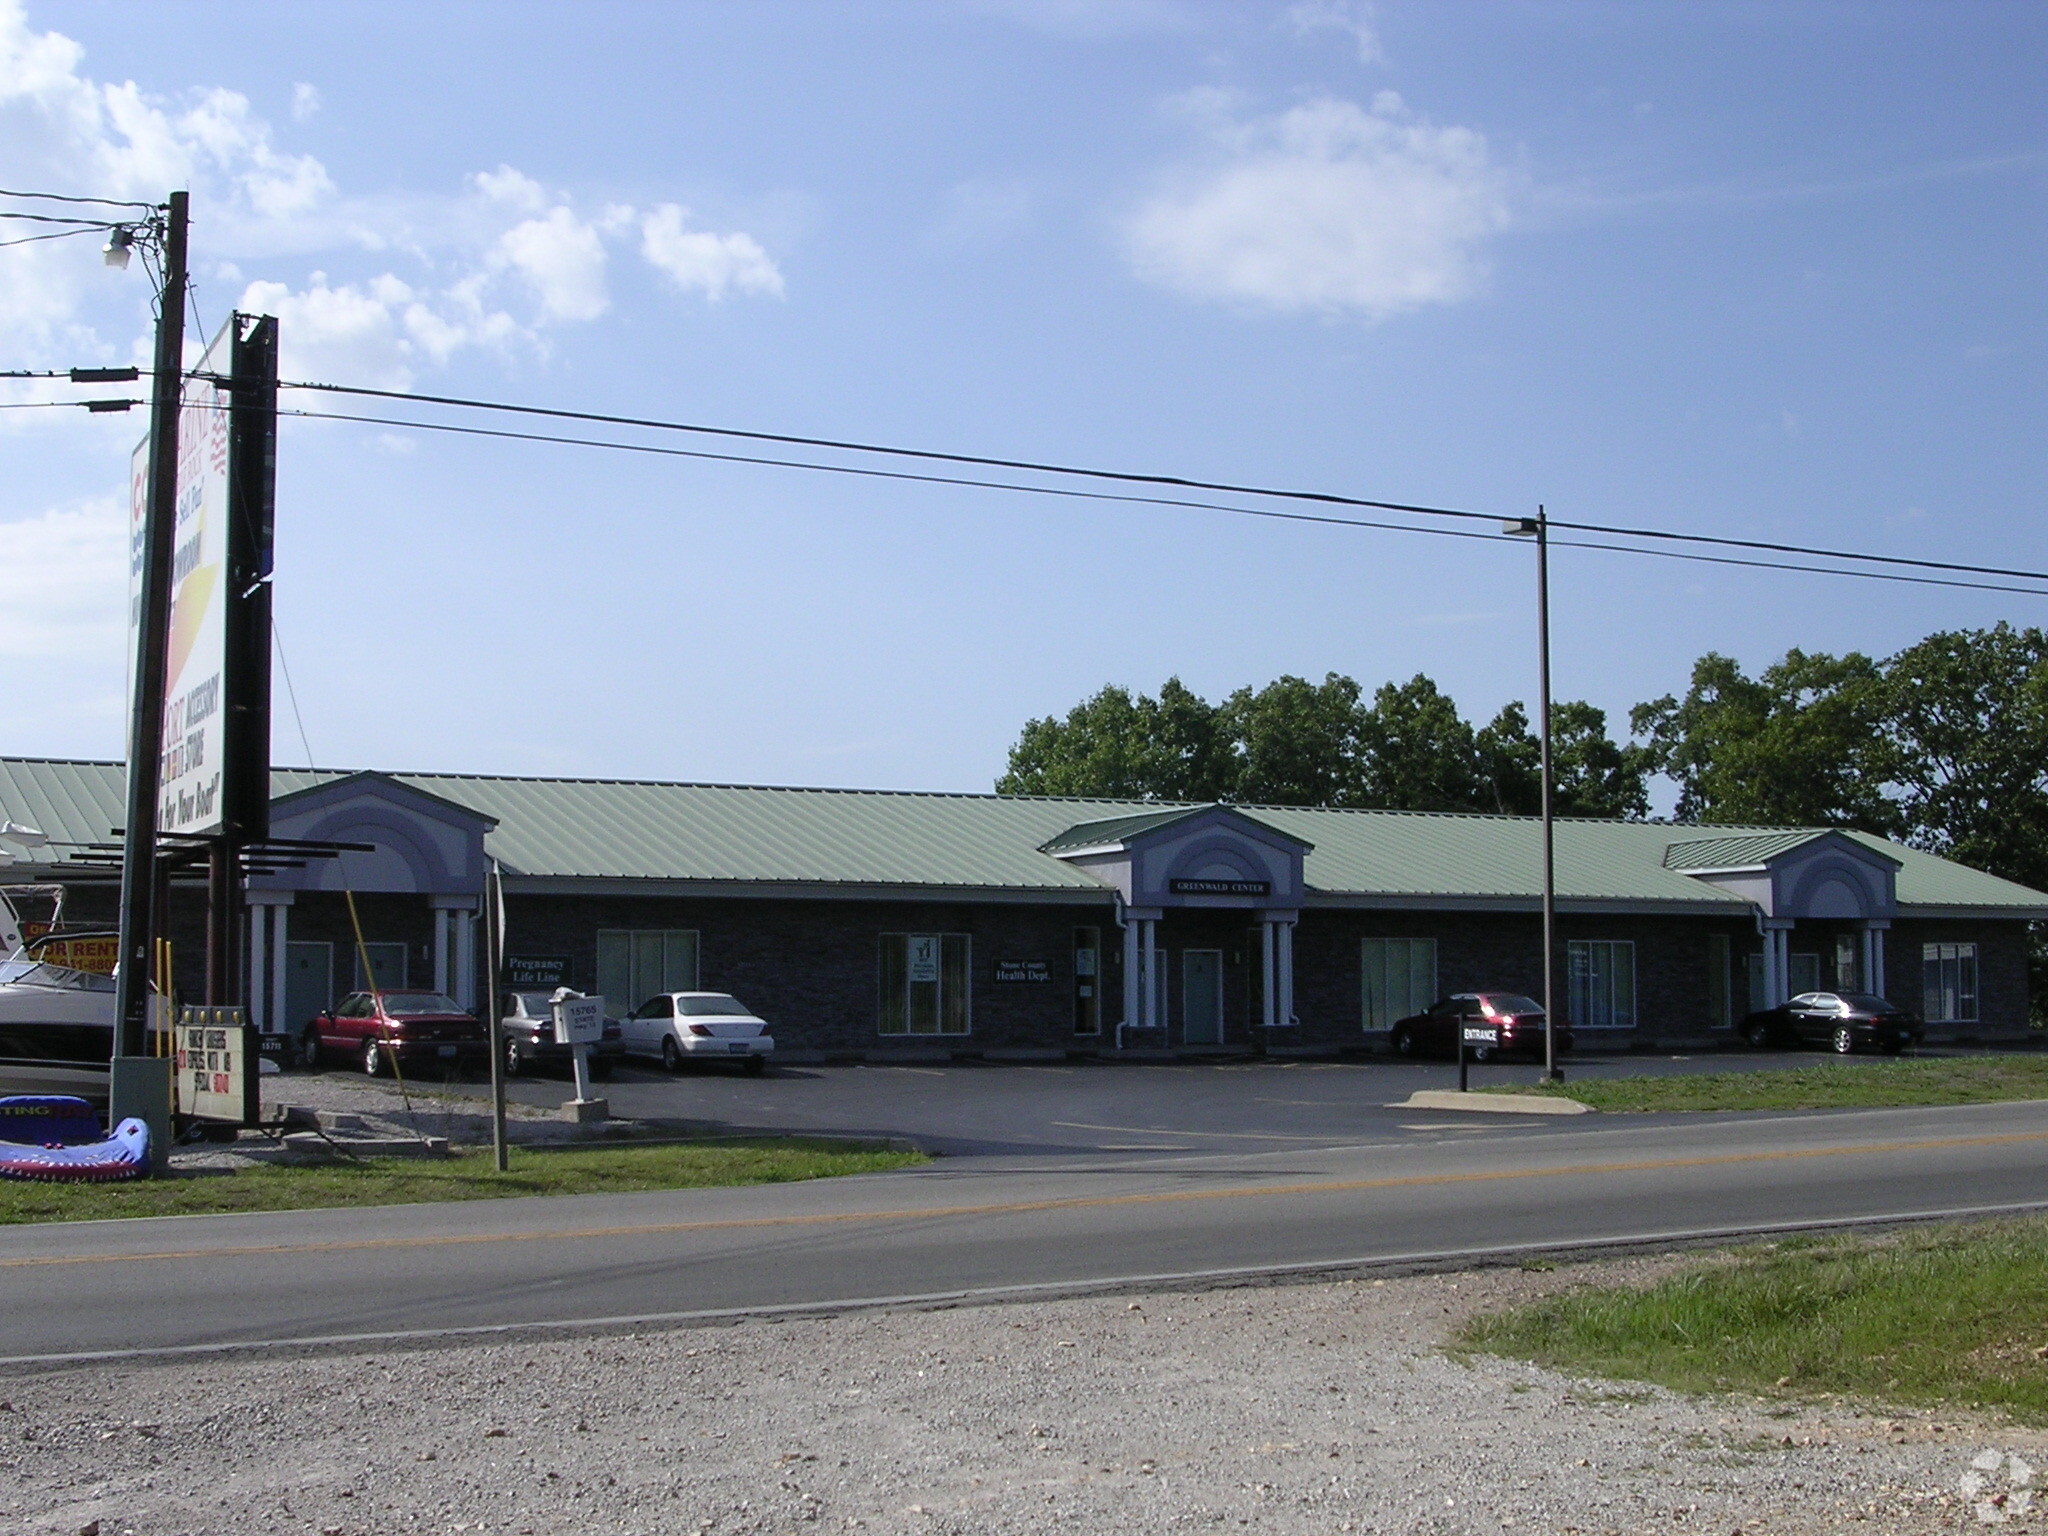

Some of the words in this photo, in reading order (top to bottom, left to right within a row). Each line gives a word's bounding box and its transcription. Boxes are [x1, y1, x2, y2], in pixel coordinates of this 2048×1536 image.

[1177, 882, 1229, 891] GREENWALD
[1231, 883, 1264, 893] CENTER
[509, 957, 564, 971] Pregnancy
[513, 971, 534, 982] Life
[537, 971, 561, 982] Line
[996, 970, 1026, 981] Health
[570, 1005, 597, 1016] 15765
[1463, 1028, 1497, 1041] ENTRANCE
